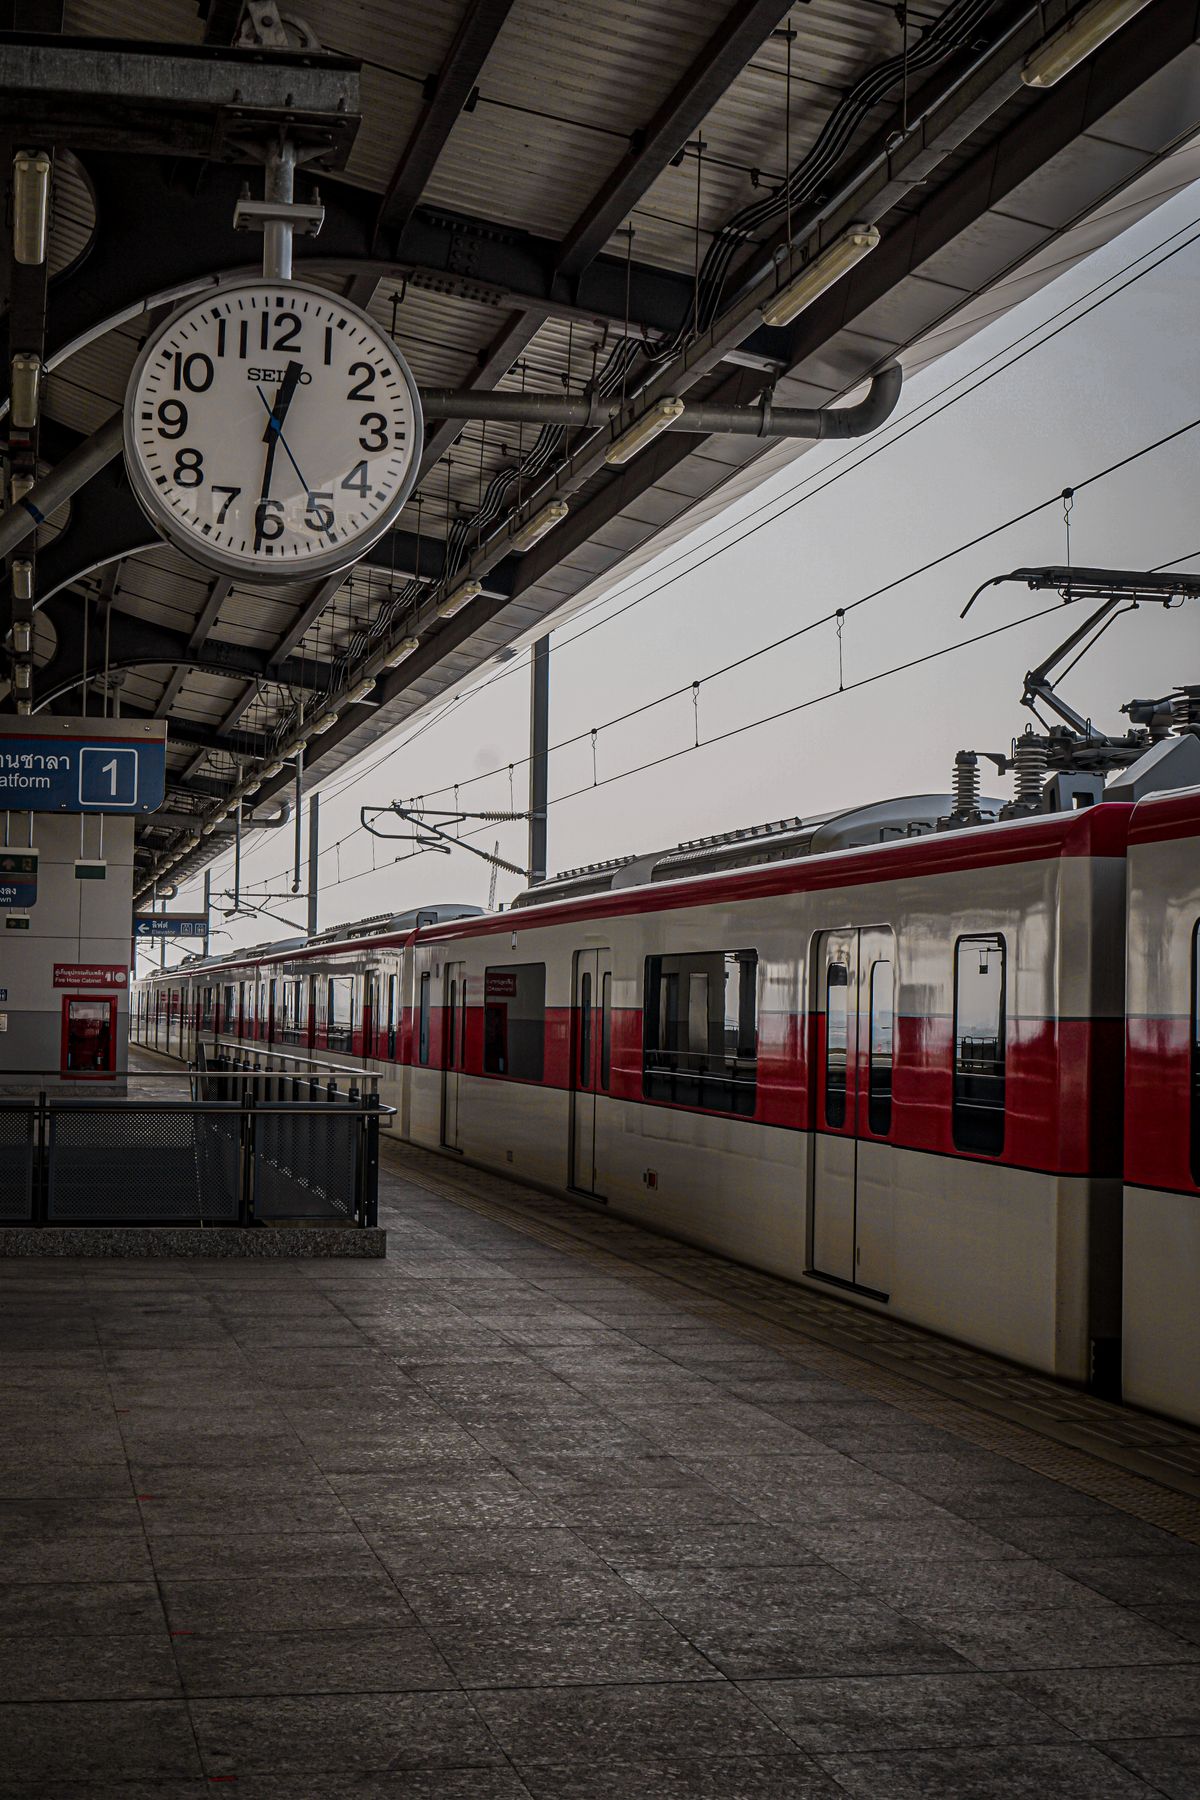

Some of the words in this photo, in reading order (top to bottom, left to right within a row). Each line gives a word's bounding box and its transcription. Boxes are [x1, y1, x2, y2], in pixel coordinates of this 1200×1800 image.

[217, 319, 248, 359] 11
[260, 311, 302, 353] 12
[324, 326, 333, 365] 1
[173, 351, 215, 393] 10
[247, 367, 312, 385] SEIO
[347, 362, 377, 401] 2
[157, 399, 188, 439] 9
[358, 412, 389, 452] 3
[173, 448, 204, 488] 8
[341, 460, 373, 498] 4
[211, 486, 241, 525] 7
[254, 499, 284, 540] 6
[304, 491, 335, 531] 5
[101, 758, 118, 796] 1
